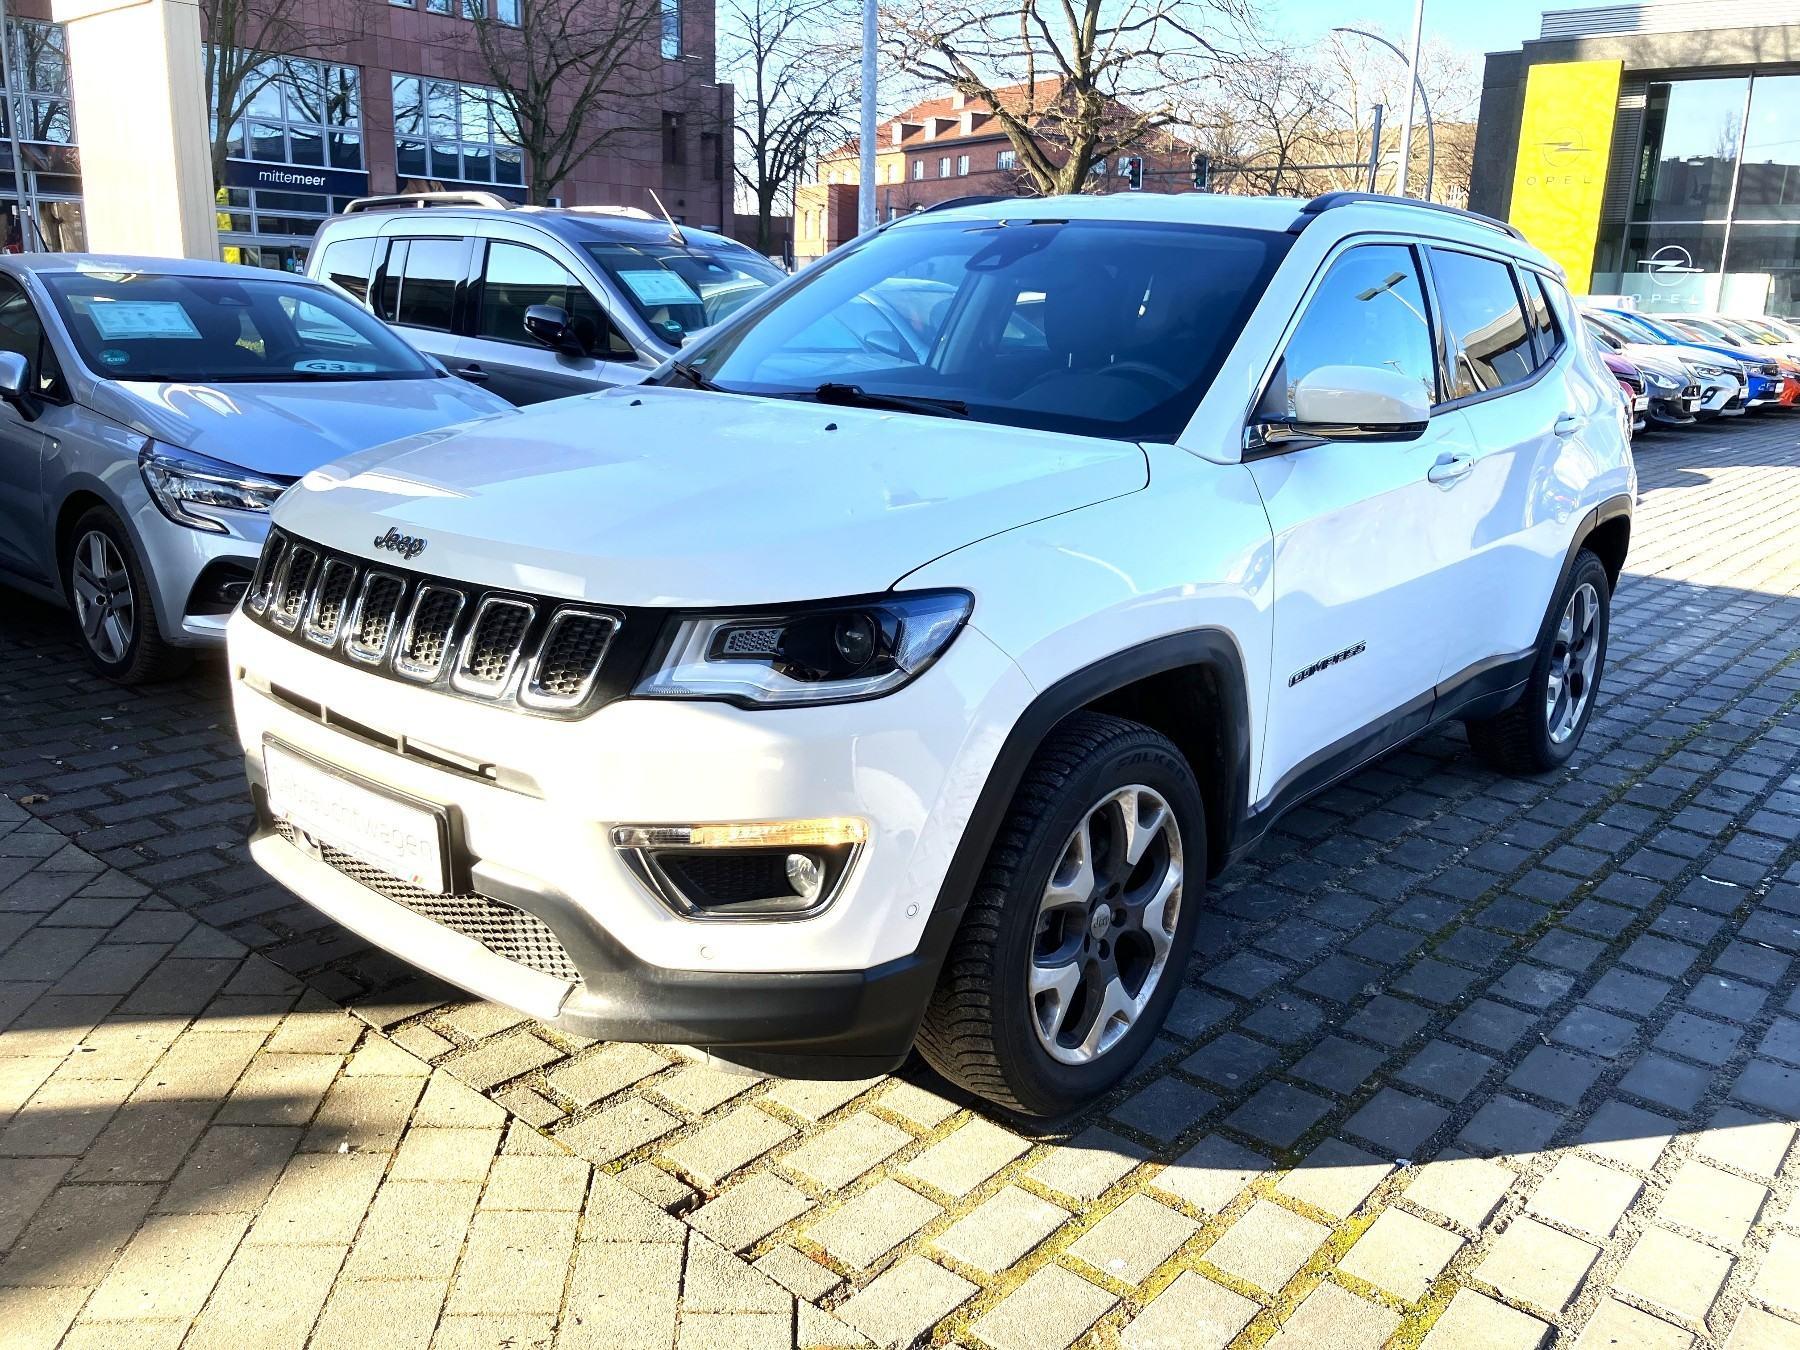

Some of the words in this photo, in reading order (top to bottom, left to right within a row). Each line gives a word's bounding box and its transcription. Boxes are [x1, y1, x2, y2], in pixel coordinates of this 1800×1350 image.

[258, 170, 326, 186] mittemeer
[1526, 176, 1592, 186] OPEL
[1631, 293, 1700, 305] OPEL
[373, 526, 428, 560] Jeep
[1288, 640, 1366, 687] COMPASS
